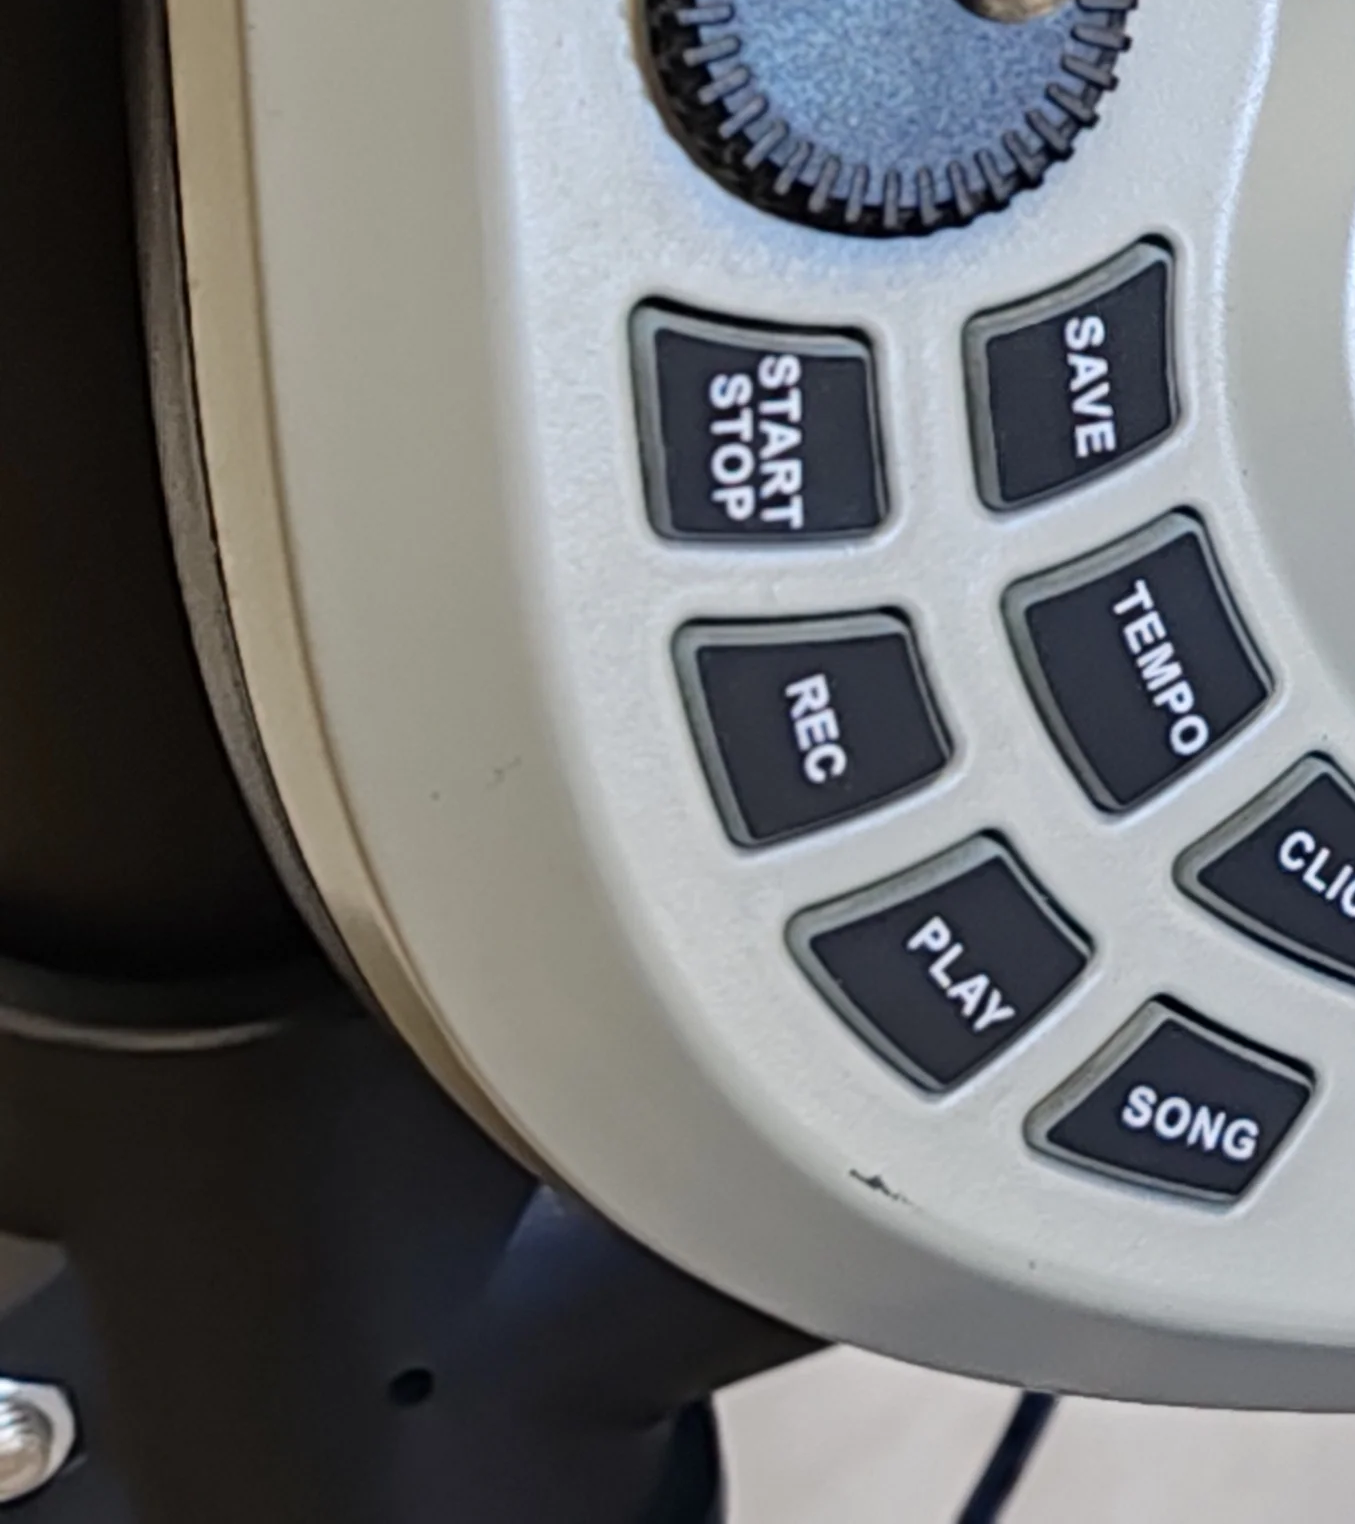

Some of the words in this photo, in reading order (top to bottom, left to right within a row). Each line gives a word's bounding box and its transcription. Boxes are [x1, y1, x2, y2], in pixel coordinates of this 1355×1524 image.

[708, 372, 757, 522] STOP
[756, 353, 805, 531] START
[1064, 314, 1118, 459] SAVE
[783, 673, 849, 784] REC
[1111, 578, 1211, 757] TEMPO
[906, 915, 1016, 1032] PLAY
[1121, 1085, 1260, 1161] SONG
